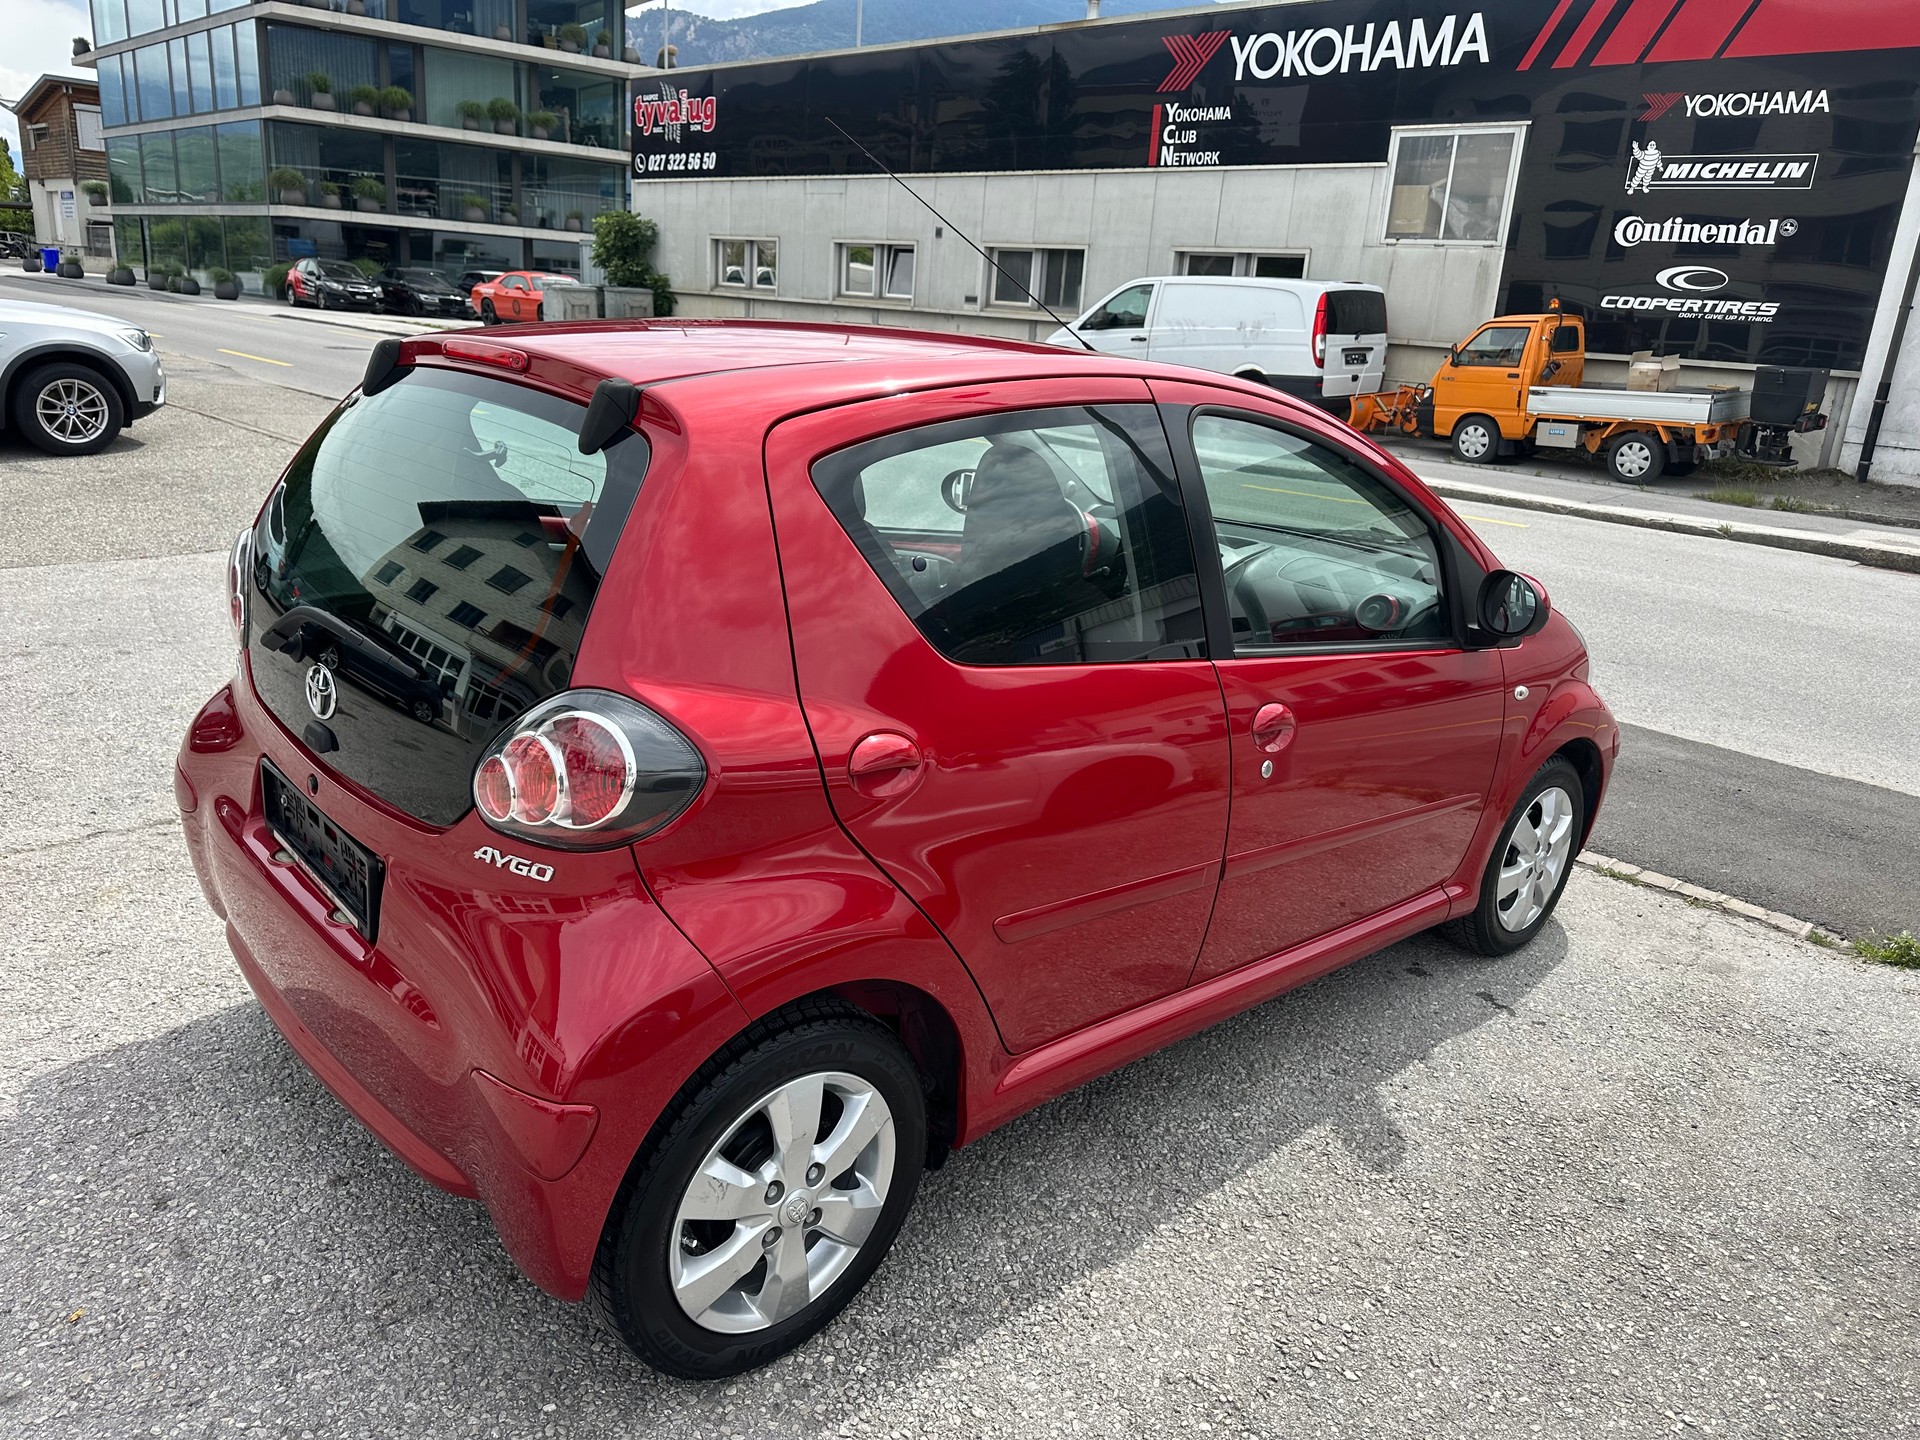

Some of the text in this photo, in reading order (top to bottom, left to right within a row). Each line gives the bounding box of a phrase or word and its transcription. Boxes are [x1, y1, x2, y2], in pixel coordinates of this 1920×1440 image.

[1229, 12, 1490, 81] YOKOHAMA
[1165, 102, 1231, 122] YOKOHAMA
[1684, 89, 1830, 117] YOKOHAMA
[1163, 124, 1197, 144] CLUB
[648, 152, 717, 171] 027 322 56 50
[1160, 145, 1220, 166] NETWORK
[1661, 162, 1809, 179] MICHELIN
[1614, 215, 1779, 247] Continental
[1600, 295, 1780, 316] COOPERTIRES
[473, 846, 555, 882] AYGO
